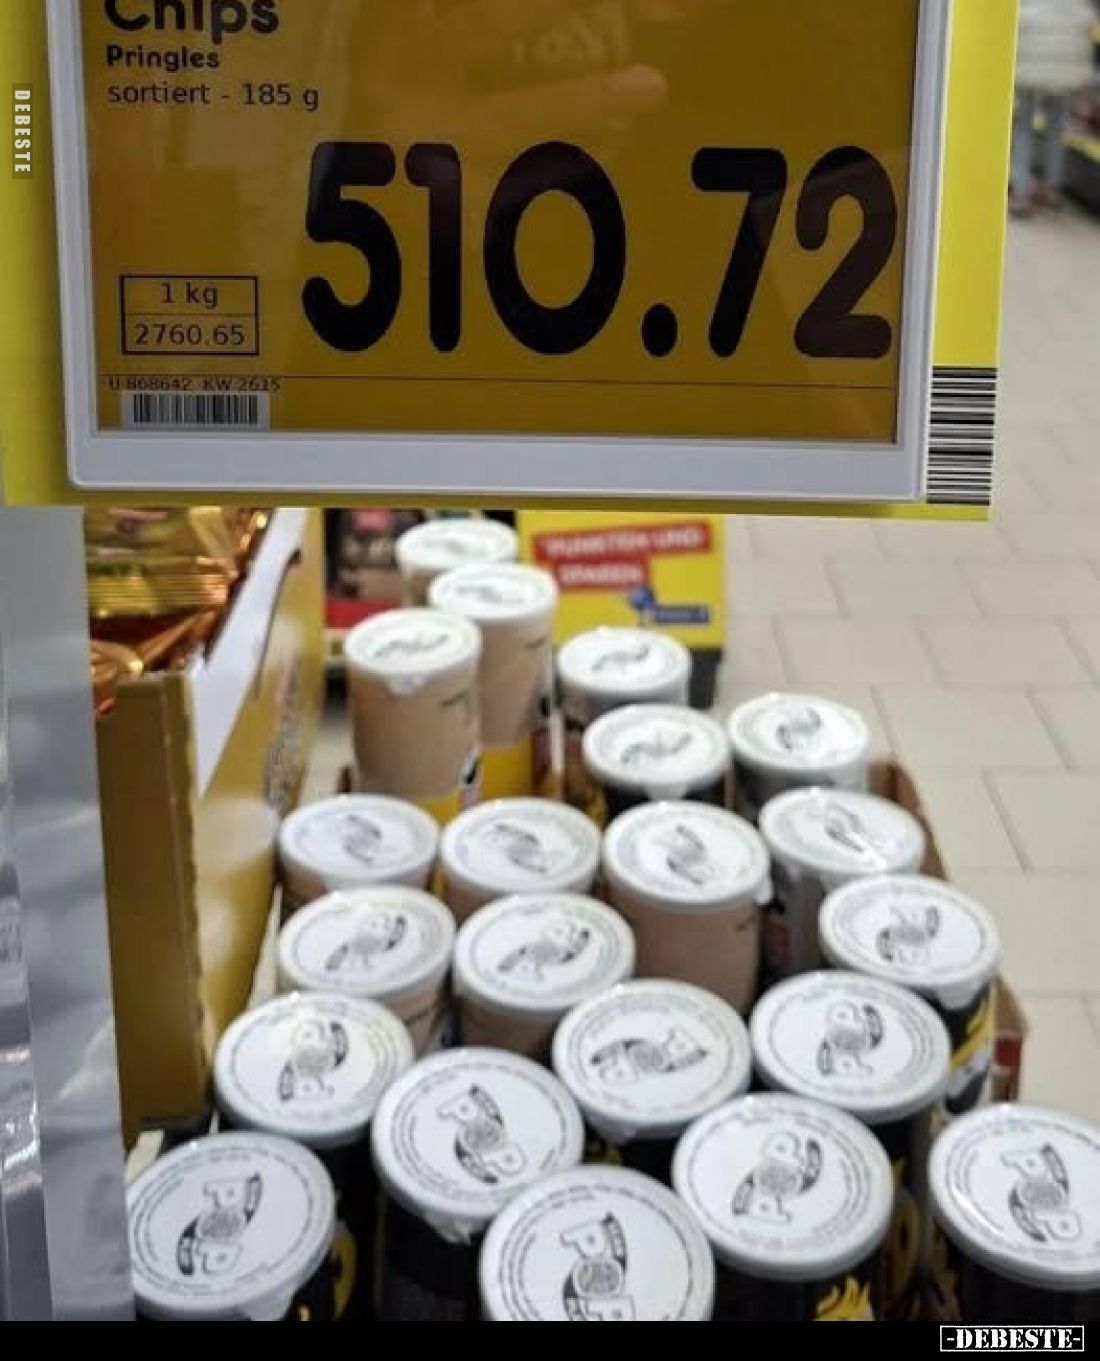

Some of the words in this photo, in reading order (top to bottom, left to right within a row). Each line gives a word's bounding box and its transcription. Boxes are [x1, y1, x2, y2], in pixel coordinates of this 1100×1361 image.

[105, 44, 220, 73] Pringles
[107, 82, 211, 106] sortiert
[242, 82, 292, 106] 185
[302, 87, 320, 112] g
[301, 140, 896, 358] 510.72
[160, 283, 174, 304] 1
[184, 282, 219, 309] kg
[134, 324, 246, 347] 2760.65
